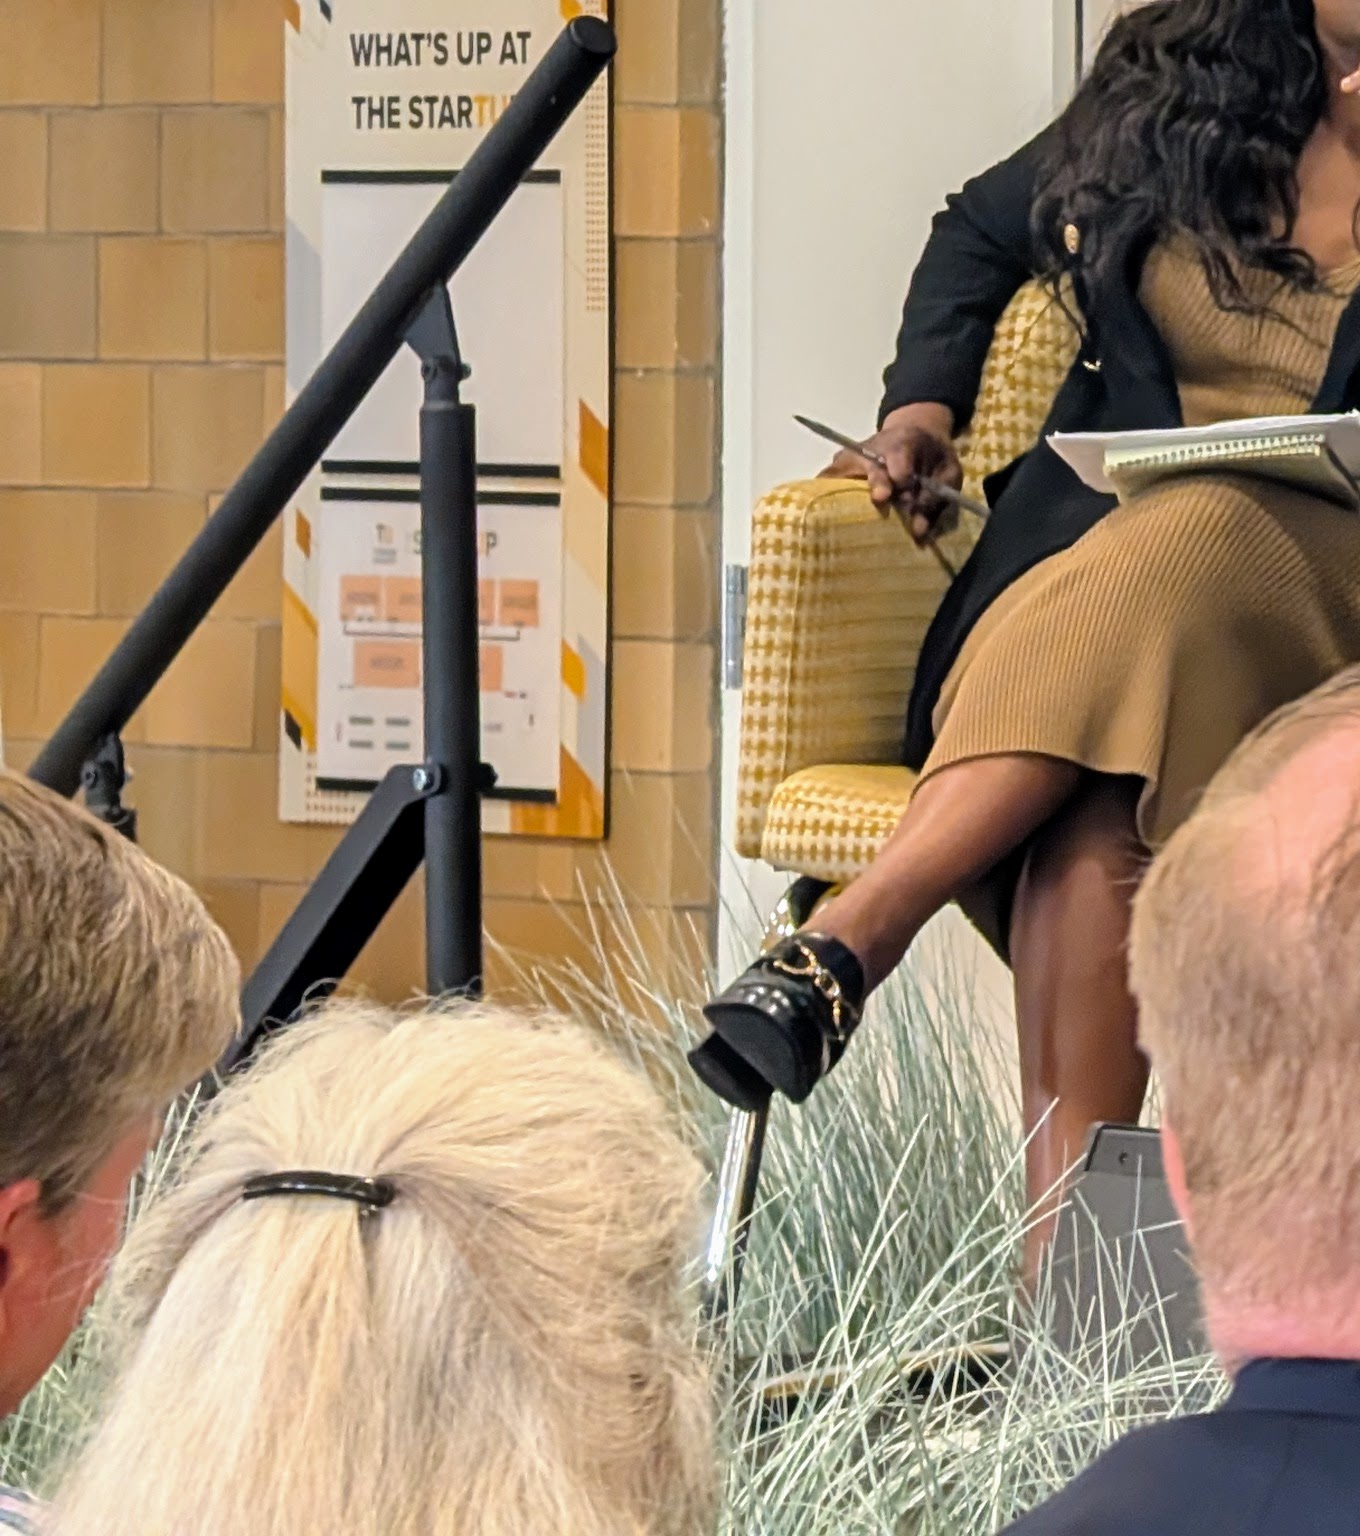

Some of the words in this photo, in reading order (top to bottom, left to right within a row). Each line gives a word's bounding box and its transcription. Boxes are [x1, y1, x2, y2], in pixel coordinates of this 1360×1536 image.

[456, 30, 492, 65] UP
[499, 31, 531, 64] AT
[352, 95, 401, 129] THE
